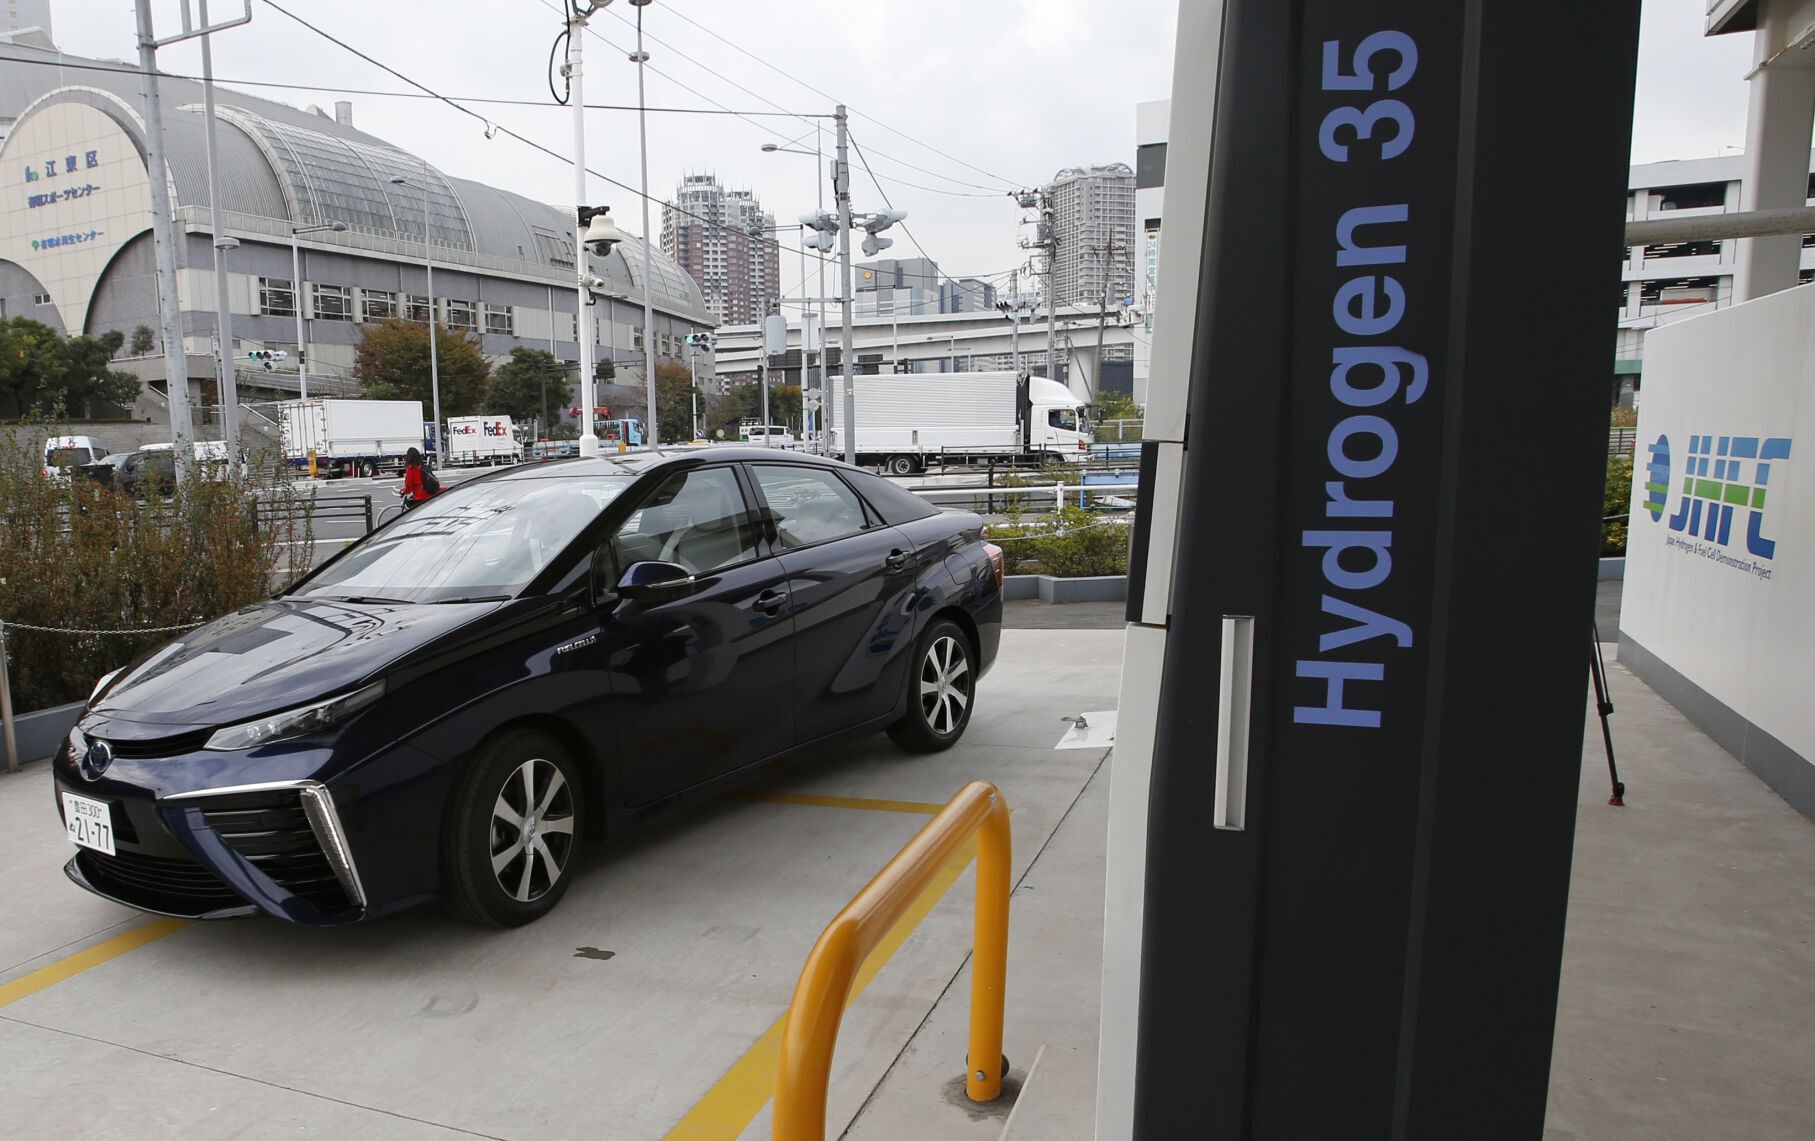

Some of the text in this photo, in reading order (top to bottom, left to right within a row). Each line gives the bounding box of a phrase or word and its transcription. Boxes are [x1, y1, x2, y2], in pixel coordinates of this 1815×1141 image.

[1293, 30, 1429, 728] Hydrogen 35
[453, 425, 476, 434] FedEx
[483, 421, 507, 436] FedEx
[1698, 544, 1707, 557] Fuel
[1707, 547, 1716, 560] Cell
[1716, 550, 1752, 573] Demonstration
[1752, 562, 1772, 580] Project
